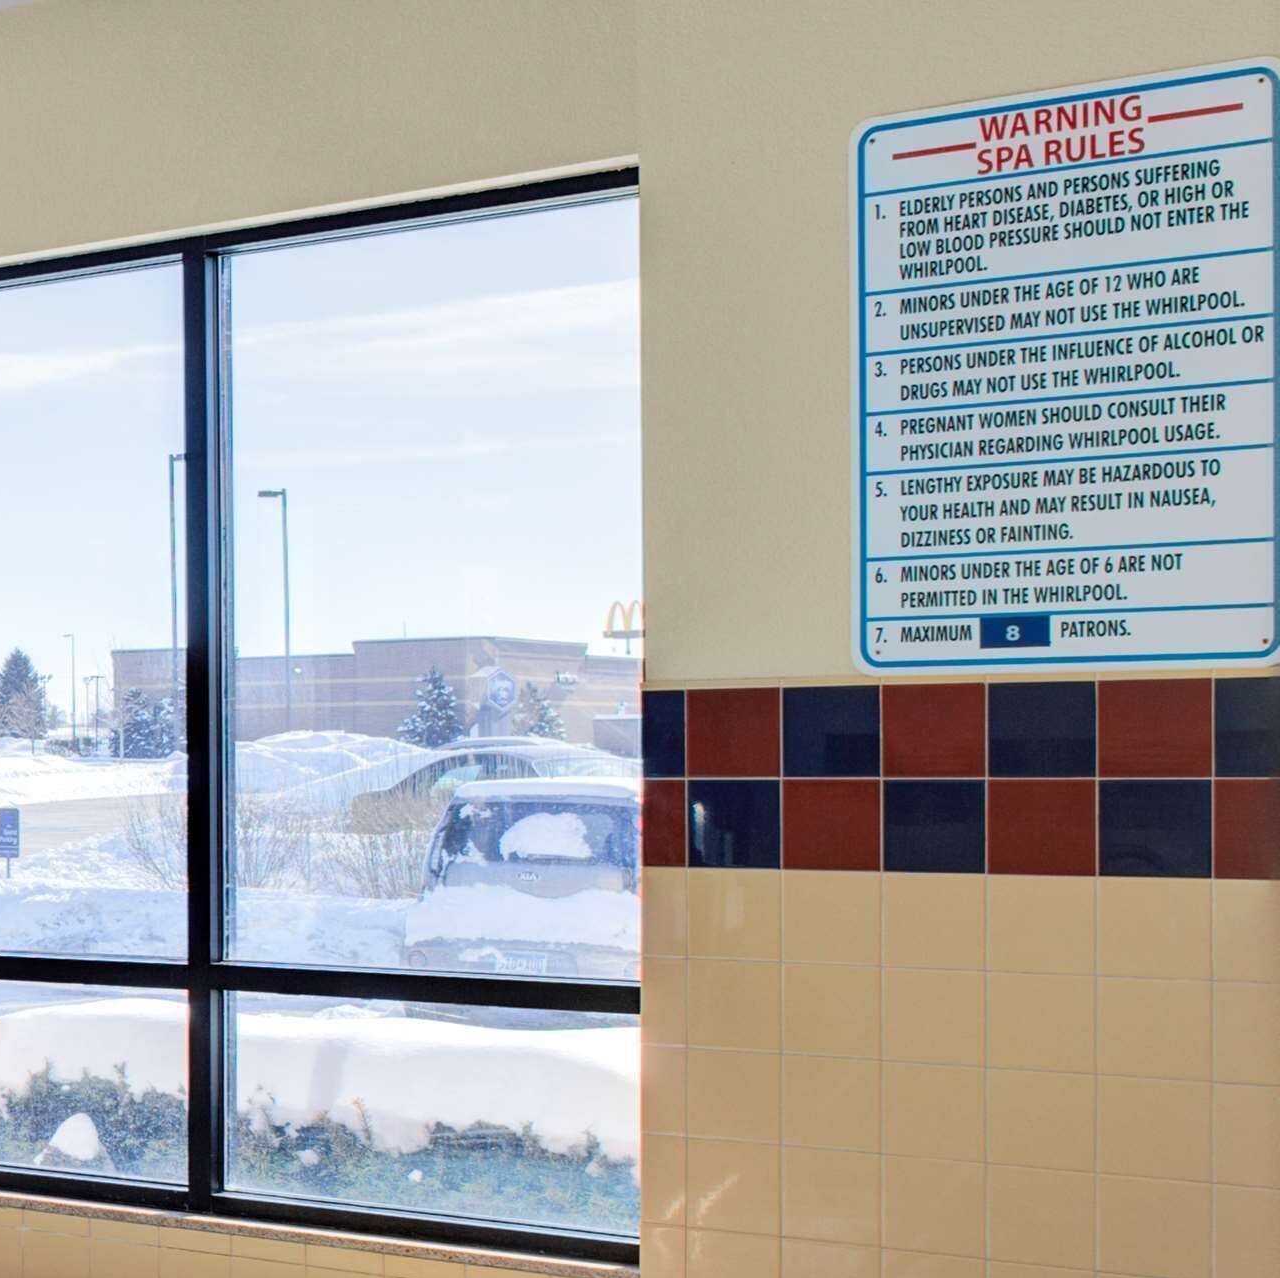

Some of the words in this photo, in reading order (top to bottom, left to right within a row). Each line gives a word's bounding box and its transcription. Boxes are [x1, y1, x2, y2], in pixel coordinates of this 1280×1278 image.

[979, 95, 1142, 142] WARNING
[977, 144, 1034, 175] SPA
[1044, 128, 1145, 166] RULES
[875, 204, 886, 220] 1.
[899, 194, 955, 217] ELDERLY
[959, 185, 1022, 209] PERSONS
[1026, 181, 1058, 200] AND
[1064, 171, 1130, 196] PERSONS
[1135, 159, 1220, 187] SUFFERING
[900, 218, 939, 238] FROM
[944, 211, 988, 232] HEART
[993, 203, 1054, 226] DISEASE,
[1059, 193, 1132, 218] DIABETES,
[1137, 190, 1159, 208] OR
[1165, 183, 1205, 205] HIGH
[1211, 180, 1233, 199] OR
[900, 240, 931, 259] LOW
[936, 234, 984, 255] BLOOD
[989, 224, 1059, 248] PRESSURE
[1064, 216, 1125, 240] SHOULD
[1131, 211, 1162, 232] NOT
[1167, 205, 1215, 227] ENTER
[1220, 201, 1249, 221] THE
[899, 256, 988, 280] WHIRLPOOL.
[874, 301, 887, 318] 2.
[900, 293, 955, 314] MINORS
[960, 287, 1009, 308] UNDER
[1014, 284, 1040, 303] THE
[1045, 280, 1074, 299] AGE
[1079, 277, 1098, 295] OF
[1105, 275, 1121, 293] 12
[1126, 270, 1166, 290] WHO
[1171, 266, 1199, 286] ARE
[900, 315, 1005, 341] UNSUPERVISED
[1010, 311, 1041, 330] MAY
[1045, 307, 1075, 326] NOT
[1080, 304, 1107, 323] USE
[1112, 300, 1140, 319] THE
[1145, 291, 1245, 316] WHIRLPOOL.
[874, 361, 887, 378] 3.
[900, 353, 961, 375] PERSONS
[966, 349, 1015, 369] UNDER
[1020, 345, 1047, 364] THE
[1052, 337, 1133, 361] INFLUENCE
[1138, 335, 1158, 353] OF
[1163, 328, 1237, 351] ALCOHOL
[1242, 325, 1264, 343] OR
[900, 381, 948, 401] DRUGS
[952, 378, 982, 397] MAY
[986, 375, 1016, 394] NOT
[1021, 372, 1047, 391] USE
[1052, 369, 1079, 388] THE
[1083, 362, 1180, 385] WHIRLPOOL.
[874, 421, 887, 437] 4.
[900, 414, 974, 435] PREGNANT
[978, 409, 1036, 429] WOMEN
[1041, 404, 1102, 425] SHOULD
[1107, 397, 1176, 419] CONSULT
[1180, 393, 1225, 413] THEIR
[901, 441, 973, 461] PHYSICIAN
[978, 434, 1064, 456] REGARDING
[1068, 426, 1159, 449] WHIRLPOOL
[1164, 422, 1220, 443] USAGE.
[875, 481, 887, 498] 5.
[901, 476, 962, 496] LENGTHY
[966, 471, 1038, 492] EXPOSURE
[1043, 469, 1074, 487] MAY
[1079, 467, 1096, 485] BE
[1102, 460, 1195, 483] HAZARDOUS
[1200, 458, 1221, 476] TO
[900, 504, 938, 522] YOUR
[943, 501, 994, 519] HEALTH
[999, 498, 1030, 516] AND
[1035, 496, 1066, 514] MAY
[1071, 493, 1122, 512] RESULT
[1128, 491, 1144, 509] IN
[1150, 487, 1215, 507] NAUSEA,
[901, 528, 971, 548] DIZZINESS
[975, 527, 995, 544] OR
[1001, 523, 1073, 543] FAINTING.
[875, 567, 887, 584] 6.
[901, 564, 956, 582] MINORS
[961, 561, 1010, 580] UNDER
[1015, 560, 1041, 577] THE
[1046, 558, 1075, 576] AGE
[1080, 557, 1099, 574] OF
[1104, 556, 1113, 573] 6
[1118, 555, 1146, 573] ARE
[1151, 553, 1182, 571] NOT
[901, 589, 977, 608] PERMITTED
[982, 589, 997, 605] IN
[1002, 587, 1029, 605] THE
[1033, 584, 1128, 603] WHIRLPOOL.
[875, 627, 887, 643] 7.
[900, 625, 972, 642] MAXIMUM
[1005, 626, 1020, 640] 8
[1061, 619, 1131, 638] PATRONS.
